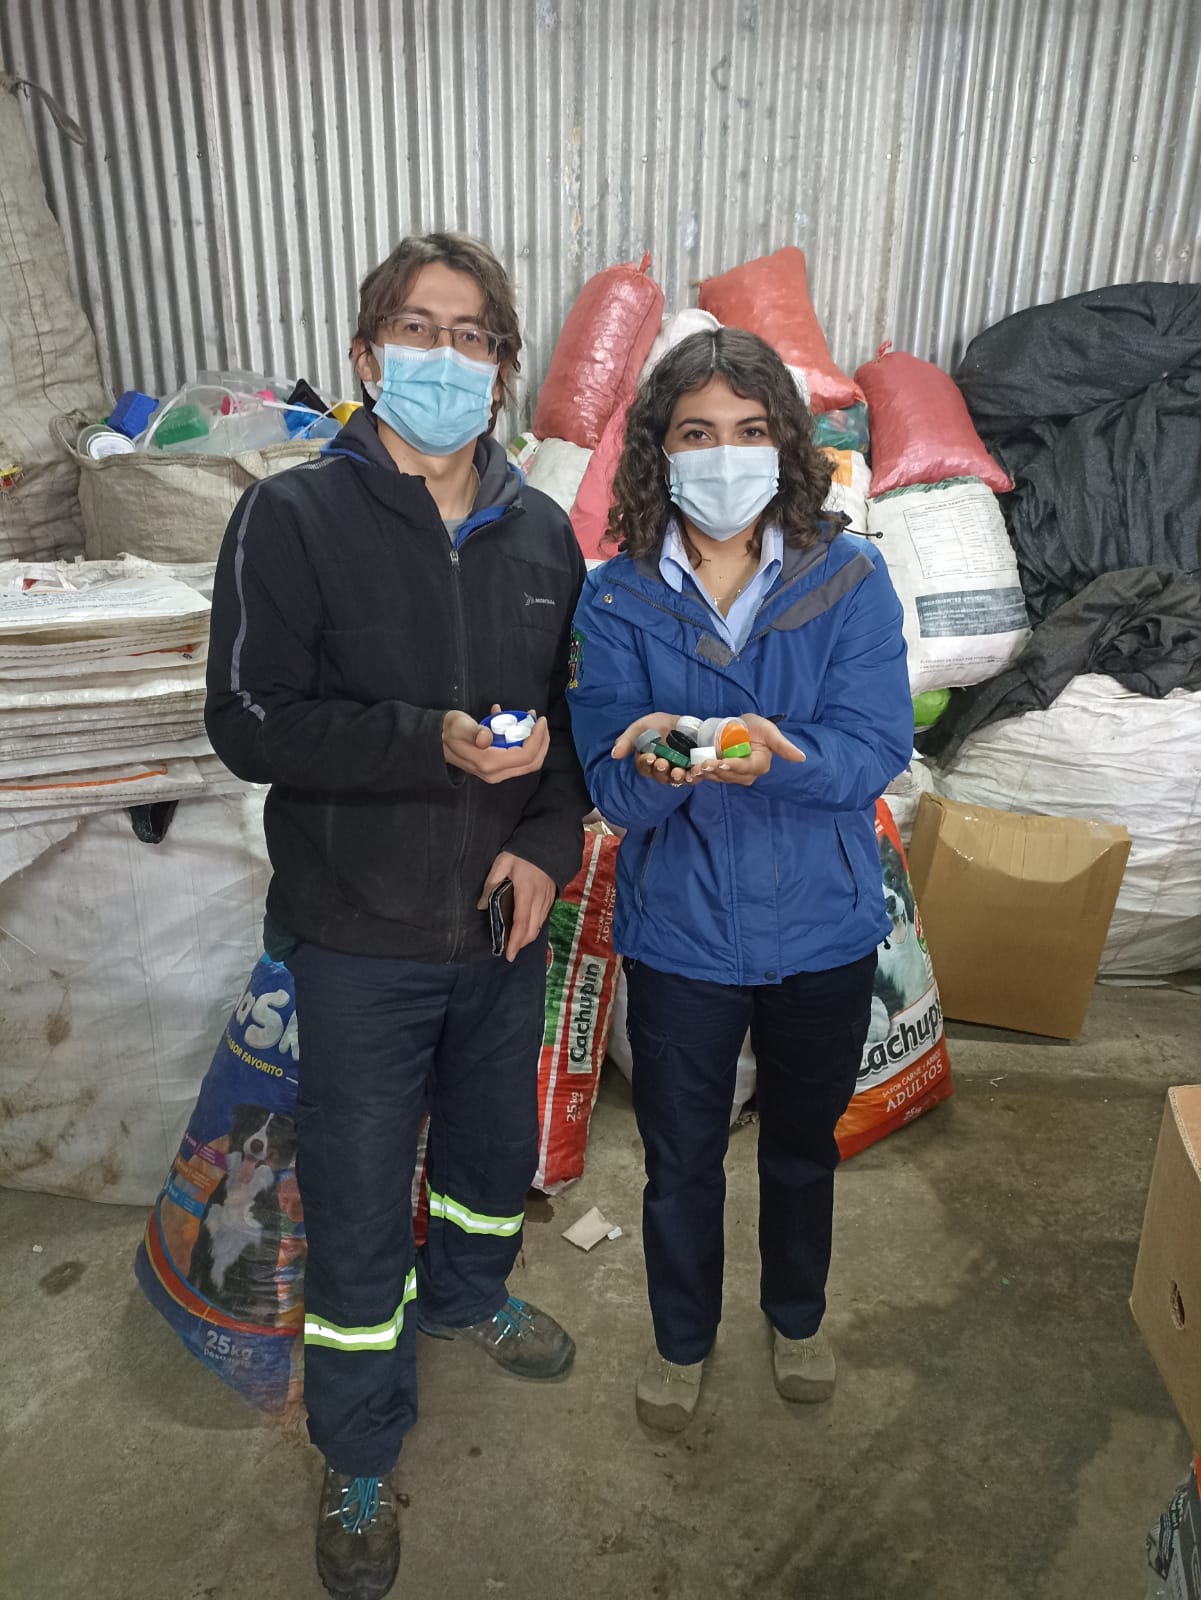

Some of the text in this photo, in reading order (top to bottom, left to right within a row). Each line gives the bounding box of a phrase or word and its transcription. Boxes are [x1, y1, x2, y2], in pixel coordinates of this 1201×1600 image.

[570, 963, 600, 1063] Cachupin
[241, 1051, 284, 1077] FAVORITO
[886, 1058, 943, 1112] ADULTOS
